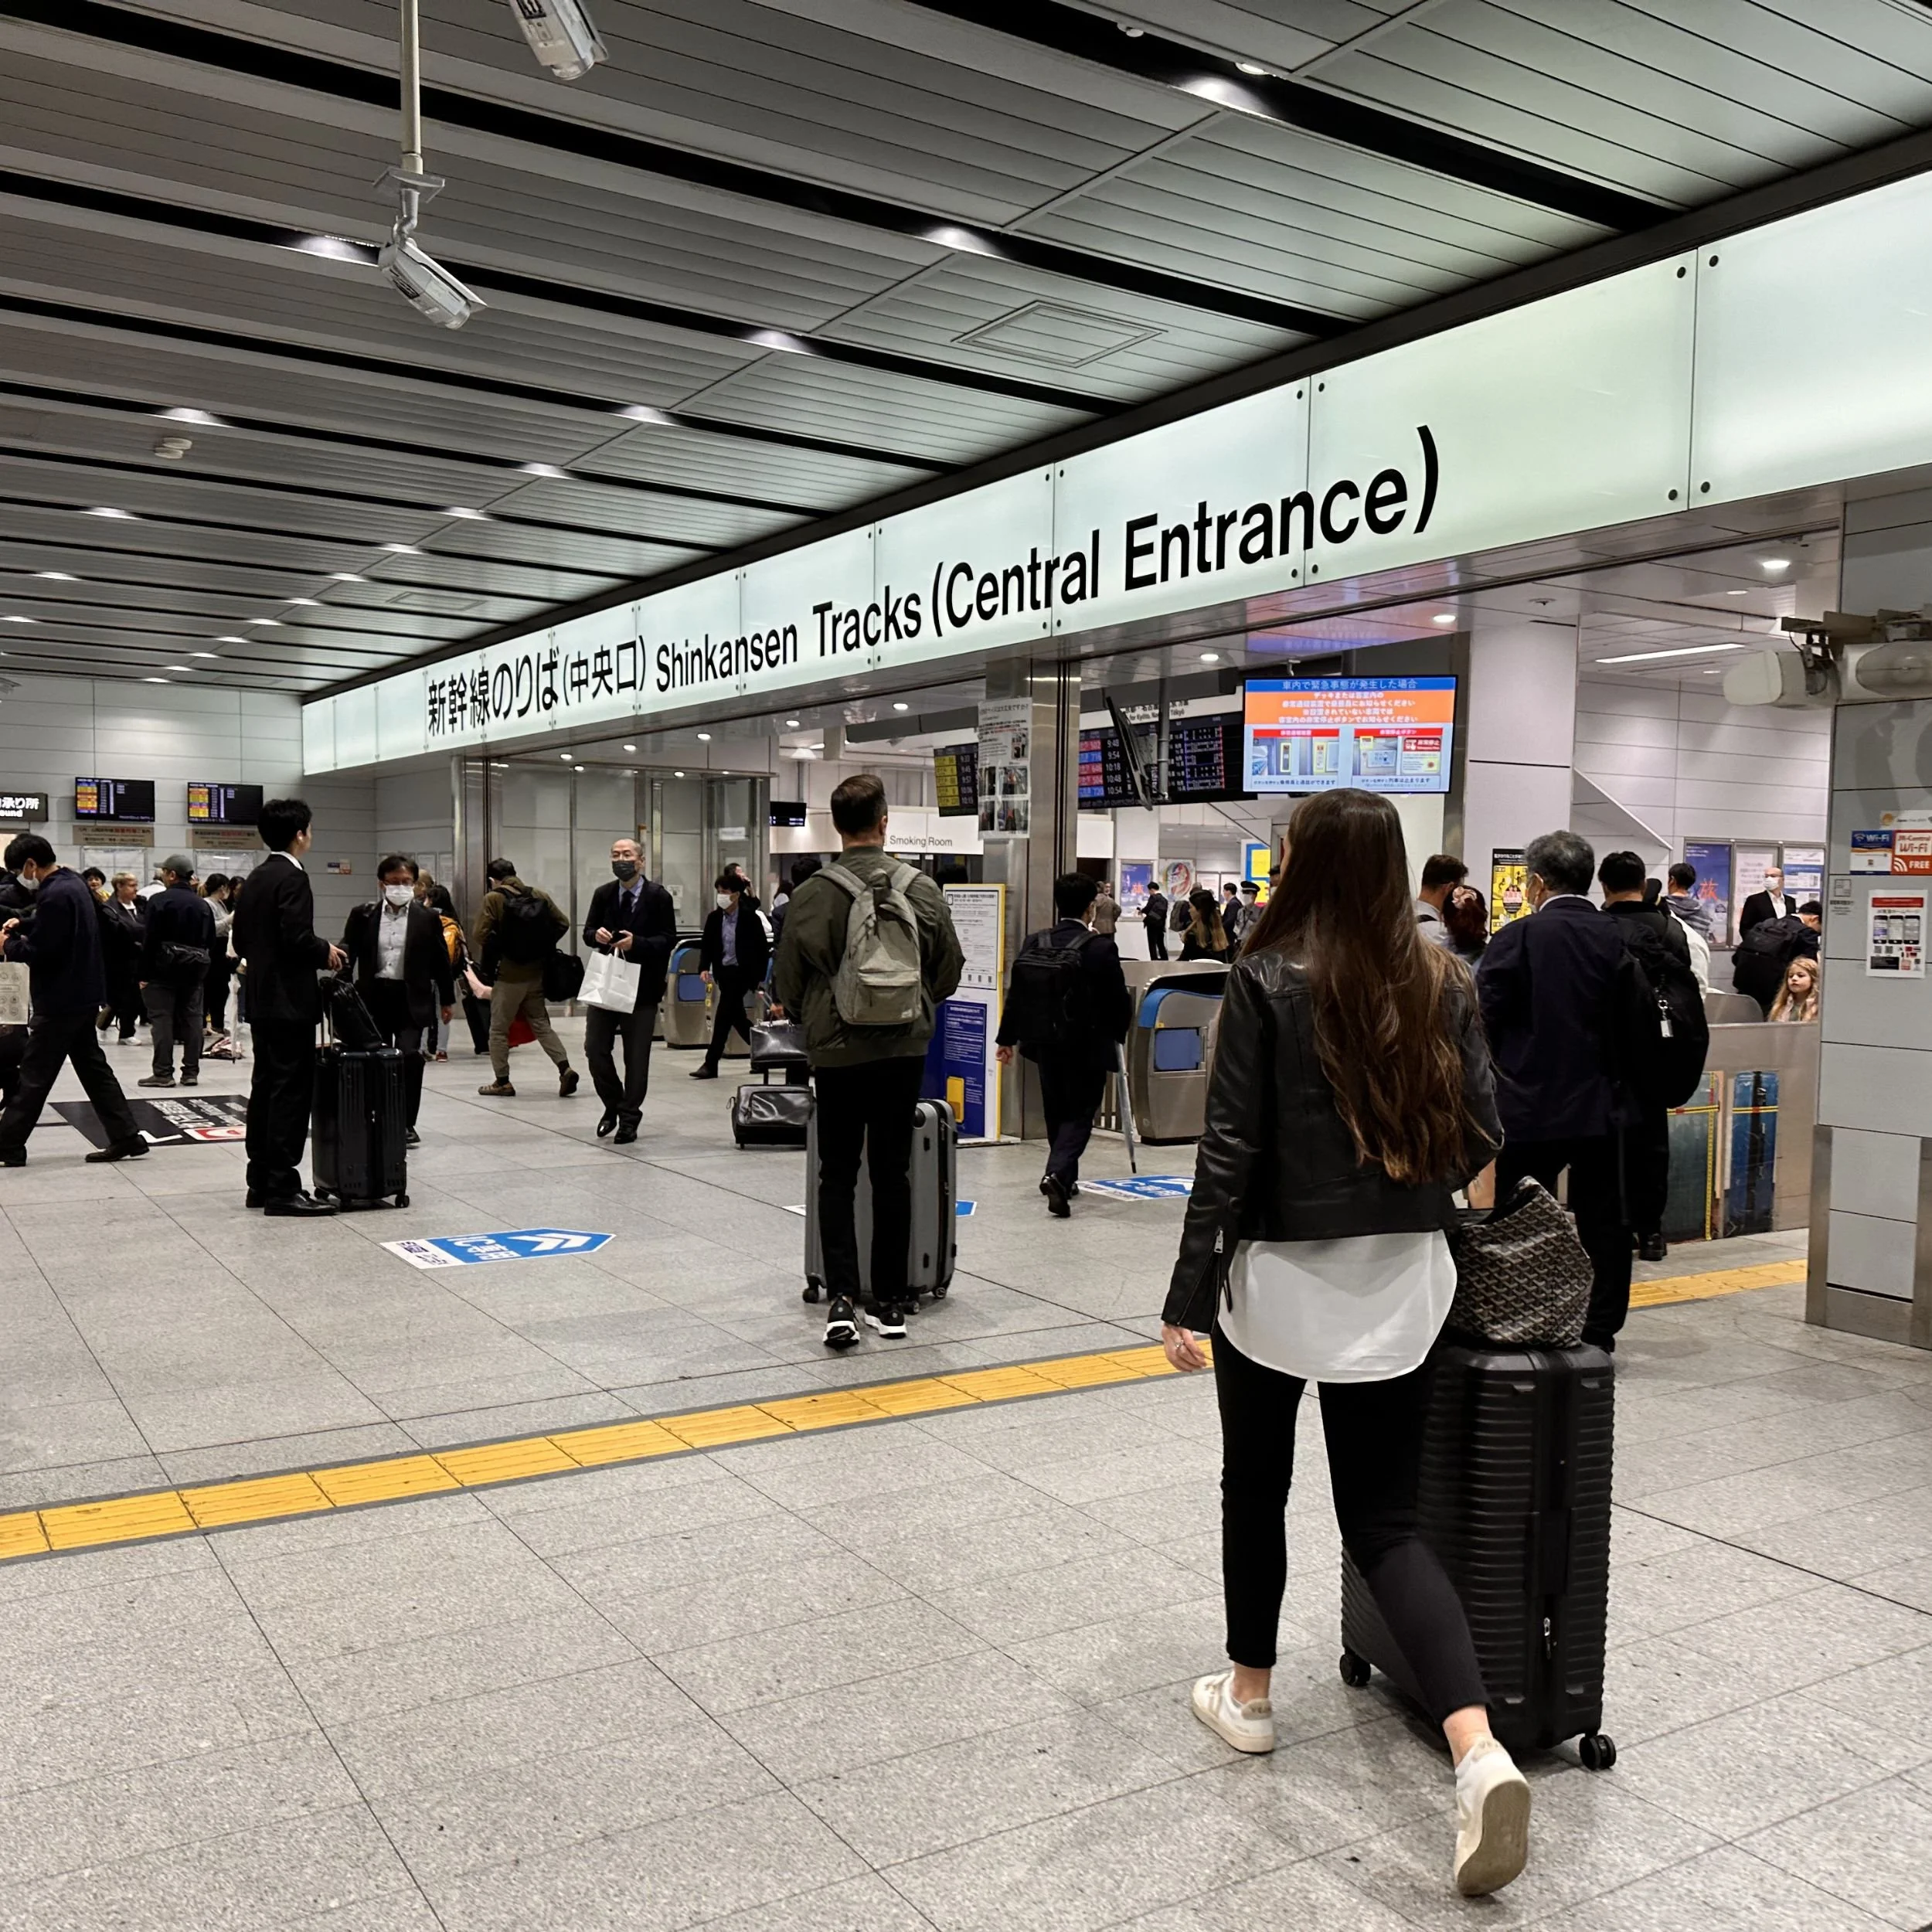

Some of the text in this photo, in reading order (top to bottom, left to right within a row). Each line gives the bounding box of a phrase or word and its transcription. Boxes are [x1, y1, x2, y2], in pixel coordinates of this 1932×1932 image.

[656, 425, 1439, 693] Shinkansen Tracks (Central Entrance)
[428, 634, 646, 736] 新幹線のりば(中央口)
[1282, 679, 1418, 690] 車内で緊急事態が発生した場合
[1107, 751, 1121, 760] 9:54
[1106, 763, 1121, 771] 10:18
[1107, 774, 1122, 783] 10:48
[1107, 787, 1123, 795] 10:54
[0, 797, 39, 810] 承り所
[889, 835, 953, 848] Smoking Room
[1866, 833, 1889, 842] Wi-Fi
[1900, 843, 1928, 853] Wi-Fi
[1909, 860, 1930, 869] FREE
[446, 1235, 522, 1260] IC専用
